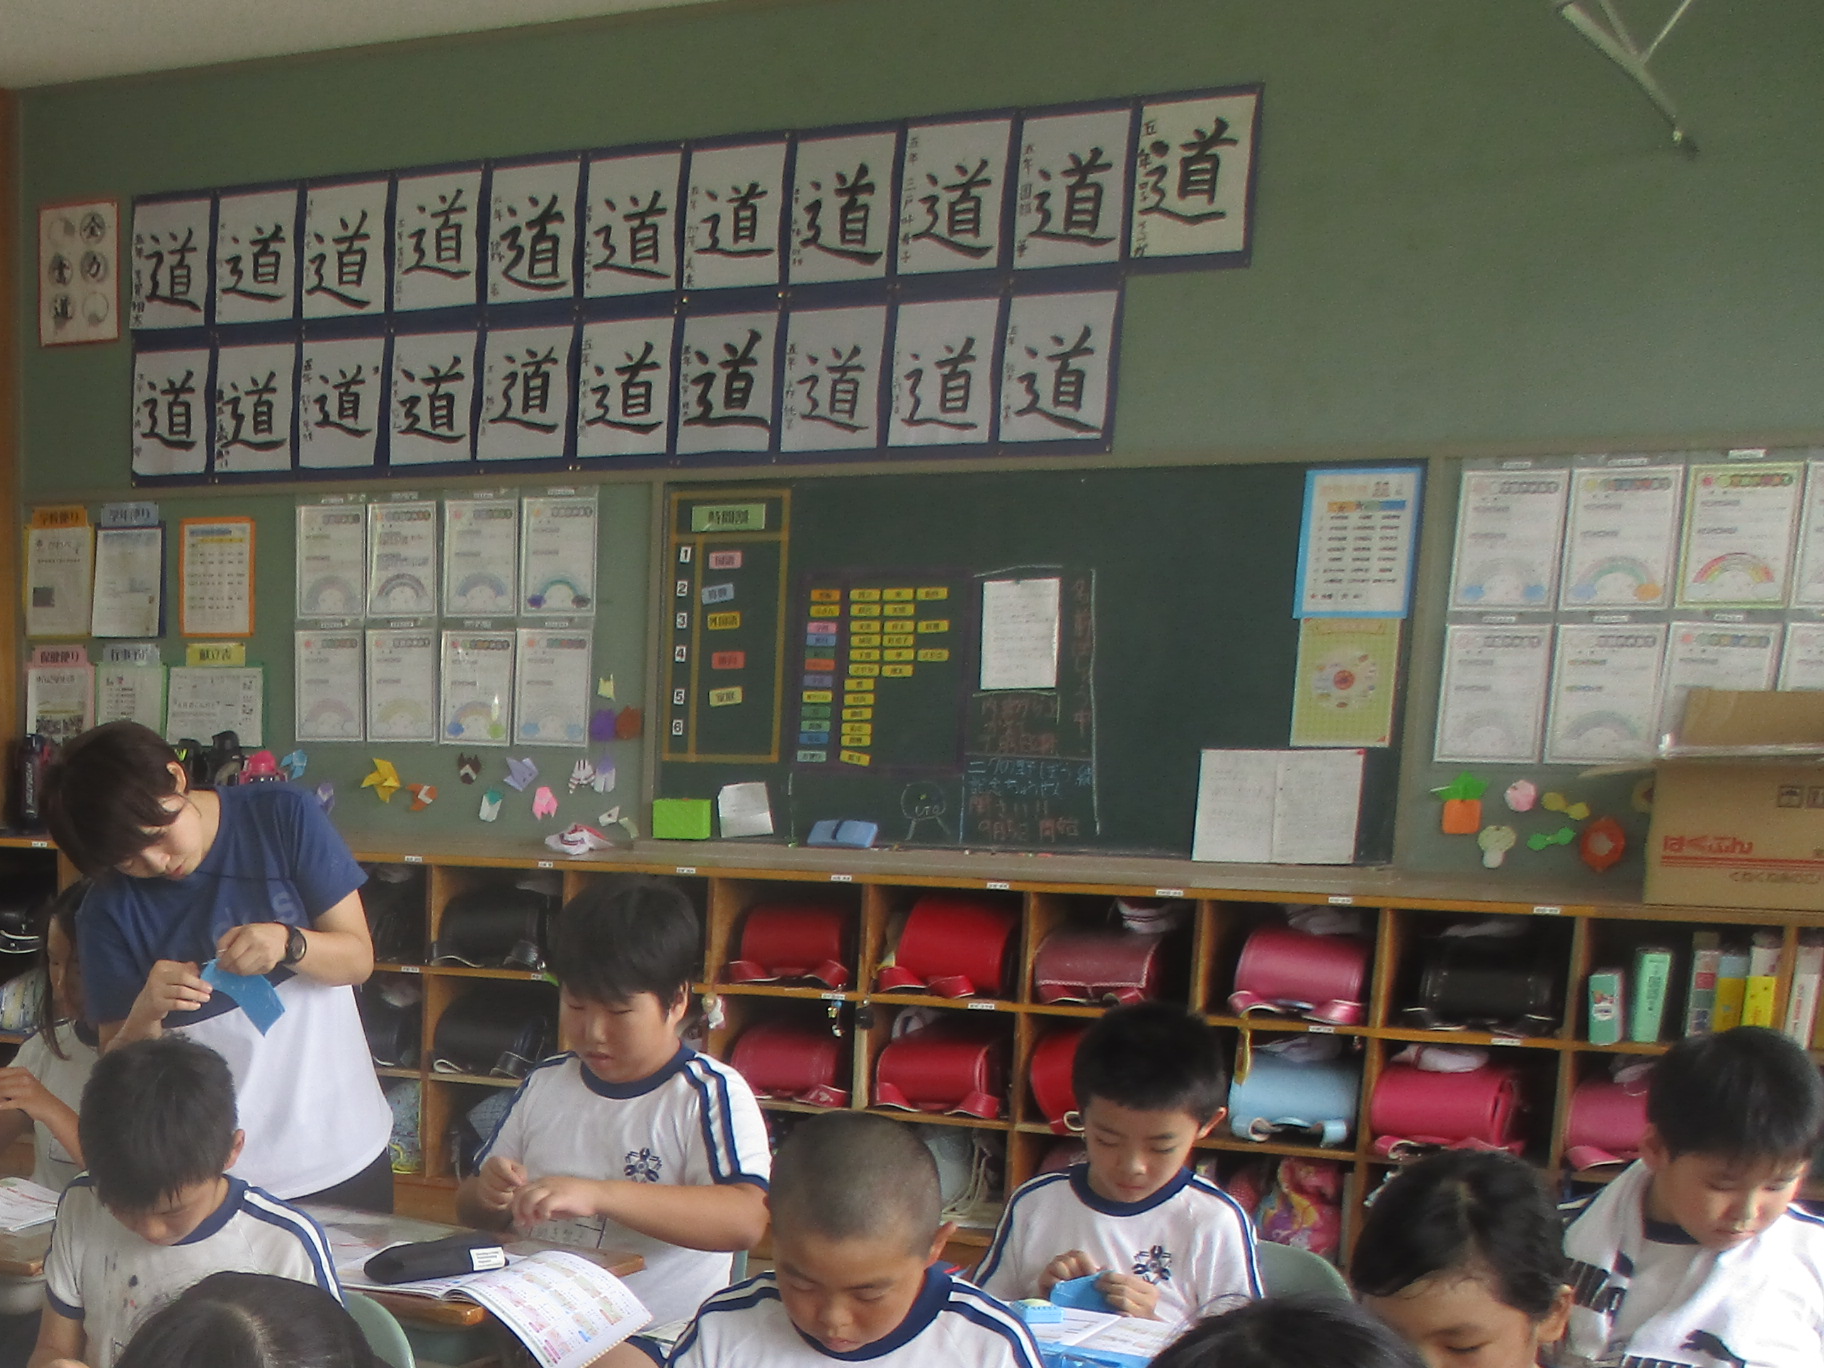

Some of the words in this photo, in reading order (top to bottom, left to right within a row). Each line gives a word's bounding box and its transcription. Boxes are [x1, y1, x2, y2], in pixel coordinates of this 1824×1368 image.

[800, 163, 883, 265] 道
[911, 158, 994, 259] 道
[1029, 146, 1116, 246] 道
[1138, 116, 1239, 225] 道
[221, 224, 286, 302] 道
[306, 210, 371, 309] 道
[402, 188, 471, 279] 道
[500, 195, 567, 292] 道
[592, 190, 671, 279] 道
[694, 182, 775, 257] 道
[145, 227, 201, 311] 道
[141, 369, 197, 450] 道
[220, 371, 287, 450] 道
[313, 364, 372, 438] 道
[398, 355, 466, 443] 道
[488, 346, 559, 434] 道
[585, 341, 663, 435] 道
[683, 328, 771, 433] 道
[797, 344, 870, 434] 道
[901, 337, 977, 431] 道
[1014, 325, 1103, 434] 道
